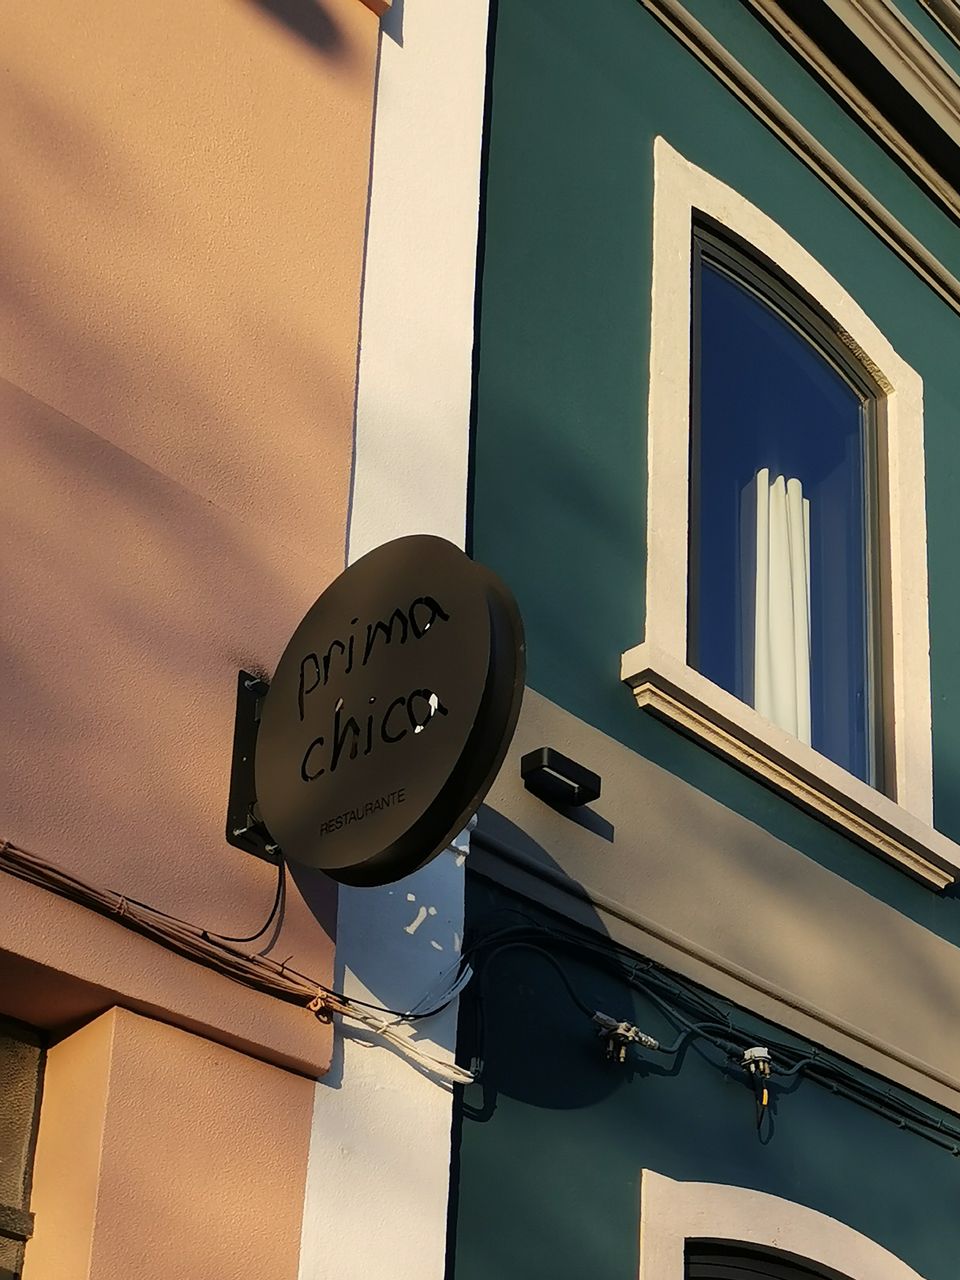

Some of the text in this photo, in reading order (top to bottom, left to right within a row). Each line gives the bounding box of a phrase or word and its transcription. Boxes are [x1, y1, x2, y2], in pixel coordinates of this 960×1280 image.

[298, 596, 450, 722] prima
[300, 688, 449, 783] chica
[319, 788, 407, 838] RESTAURANTE
